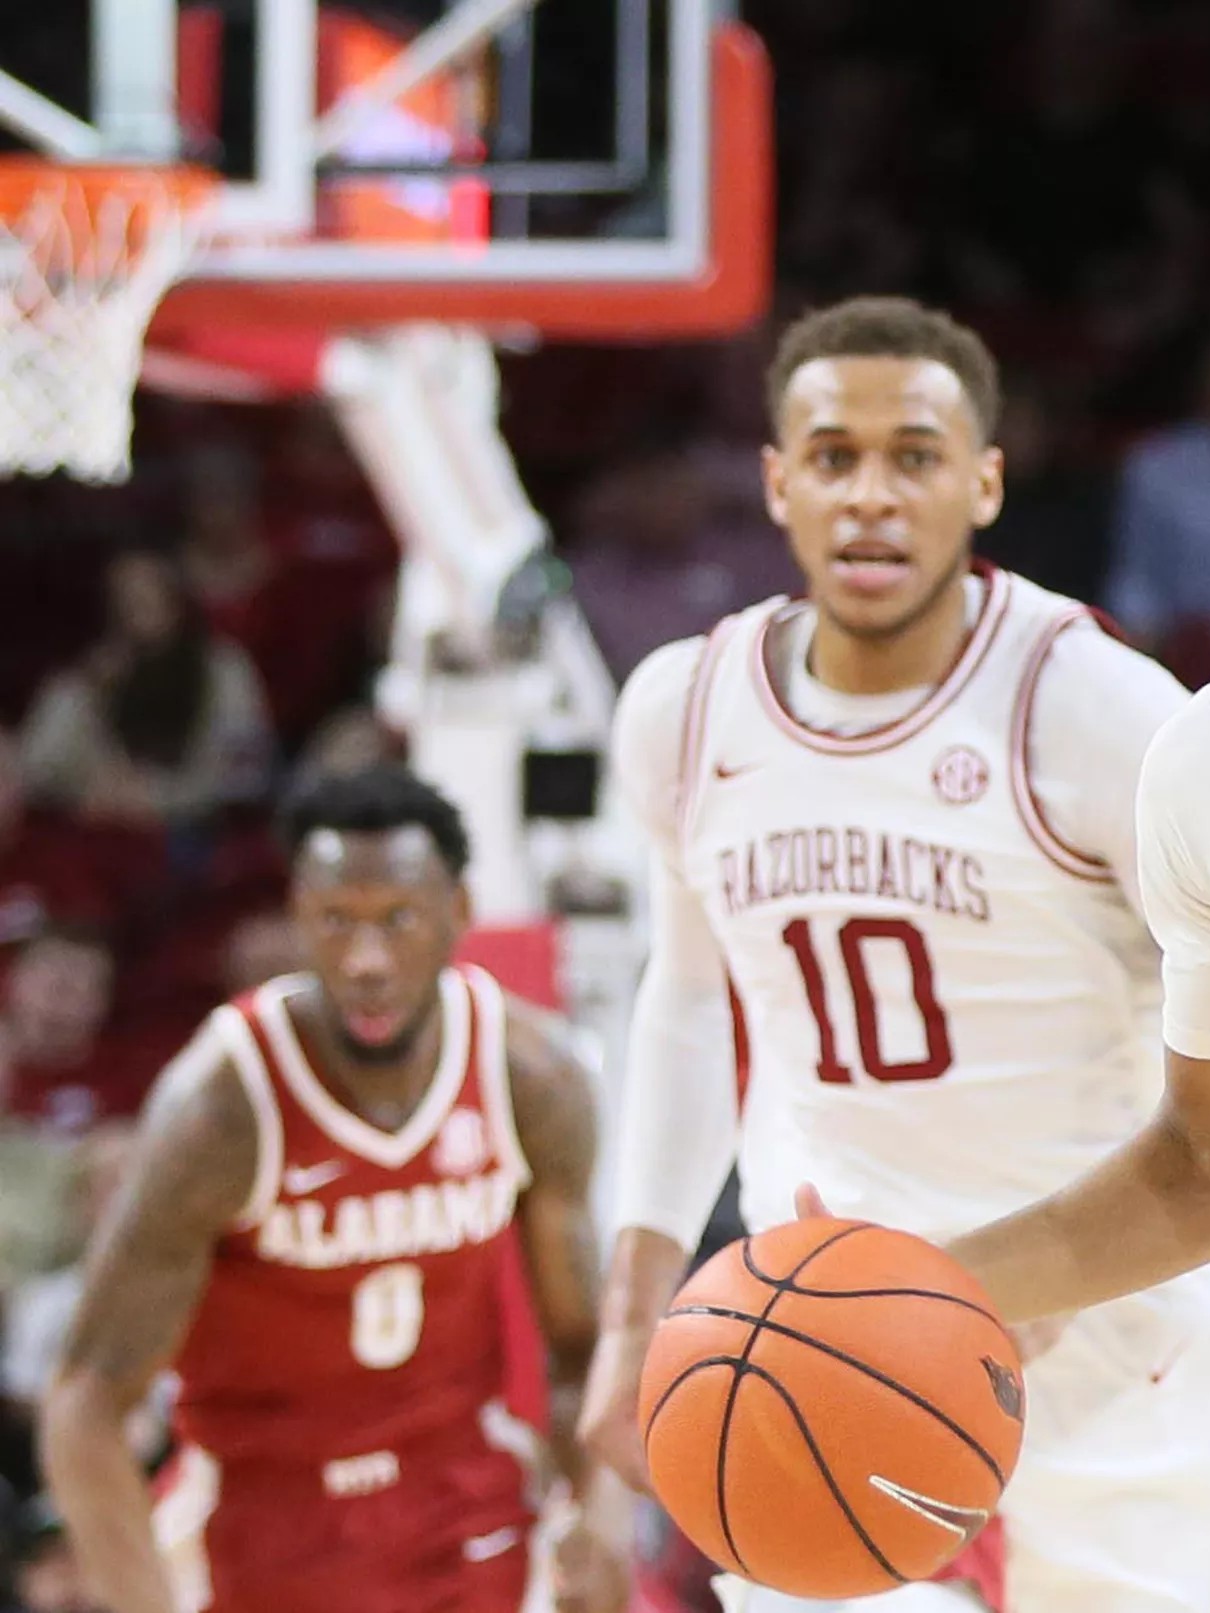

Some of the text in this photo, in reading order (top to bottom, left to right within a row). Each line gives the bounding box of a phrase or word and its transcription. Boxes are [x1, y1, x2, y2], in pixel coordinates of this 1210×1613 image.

[717, 826, 991, 922] RAZORBACKS
[782, 918, 953, 1084] 10
[351, 1262, 425, 1370] 0
